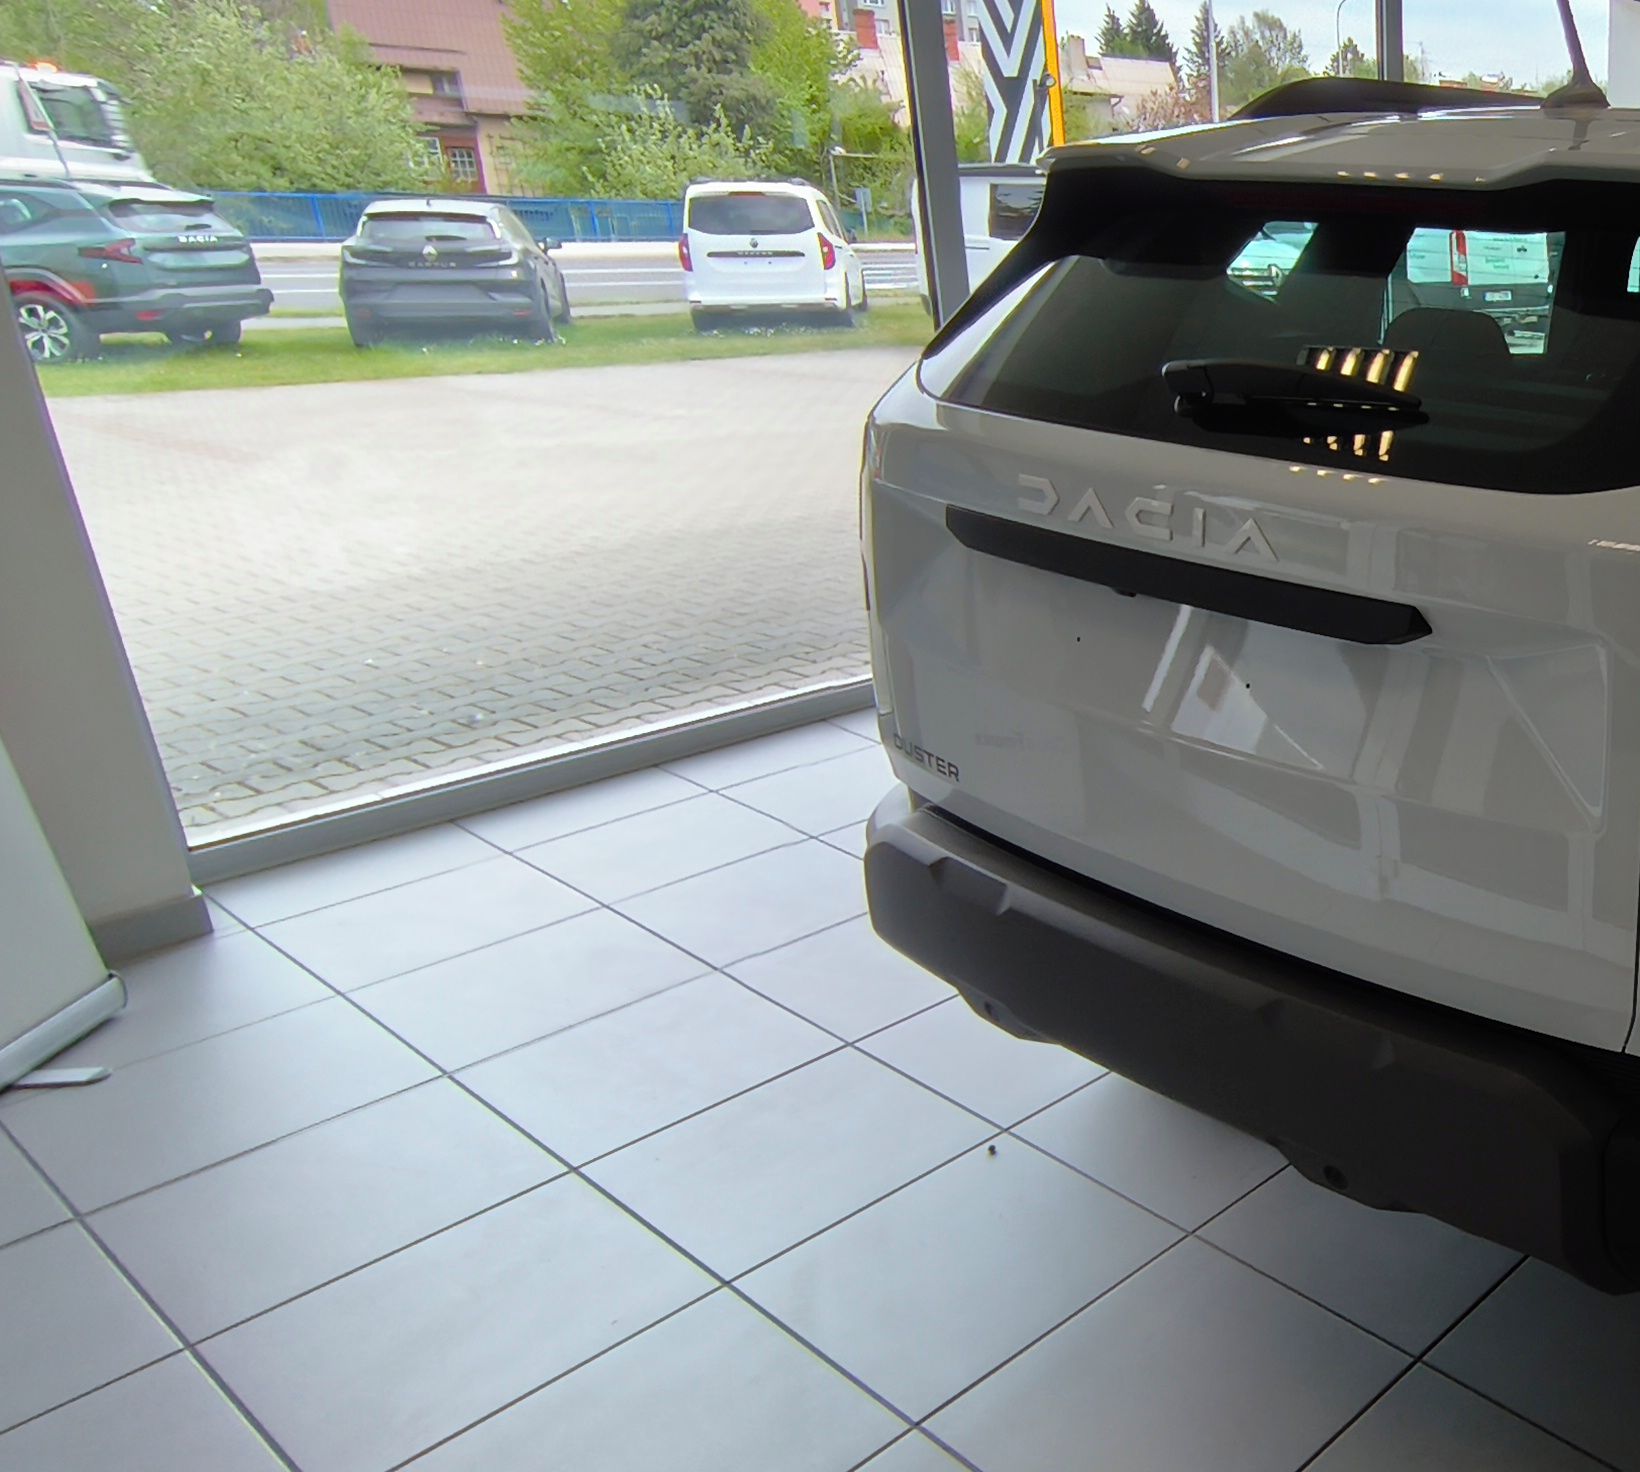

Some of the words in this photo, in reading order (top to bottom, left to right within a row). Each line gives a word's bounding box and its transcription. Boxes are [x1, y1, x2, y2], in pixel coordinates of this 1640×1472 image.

[178, 235, 218, 243] DACIA
[1018, 473, 1281, 562] DACIA
[893, 733, 961, 782] DUSTER
